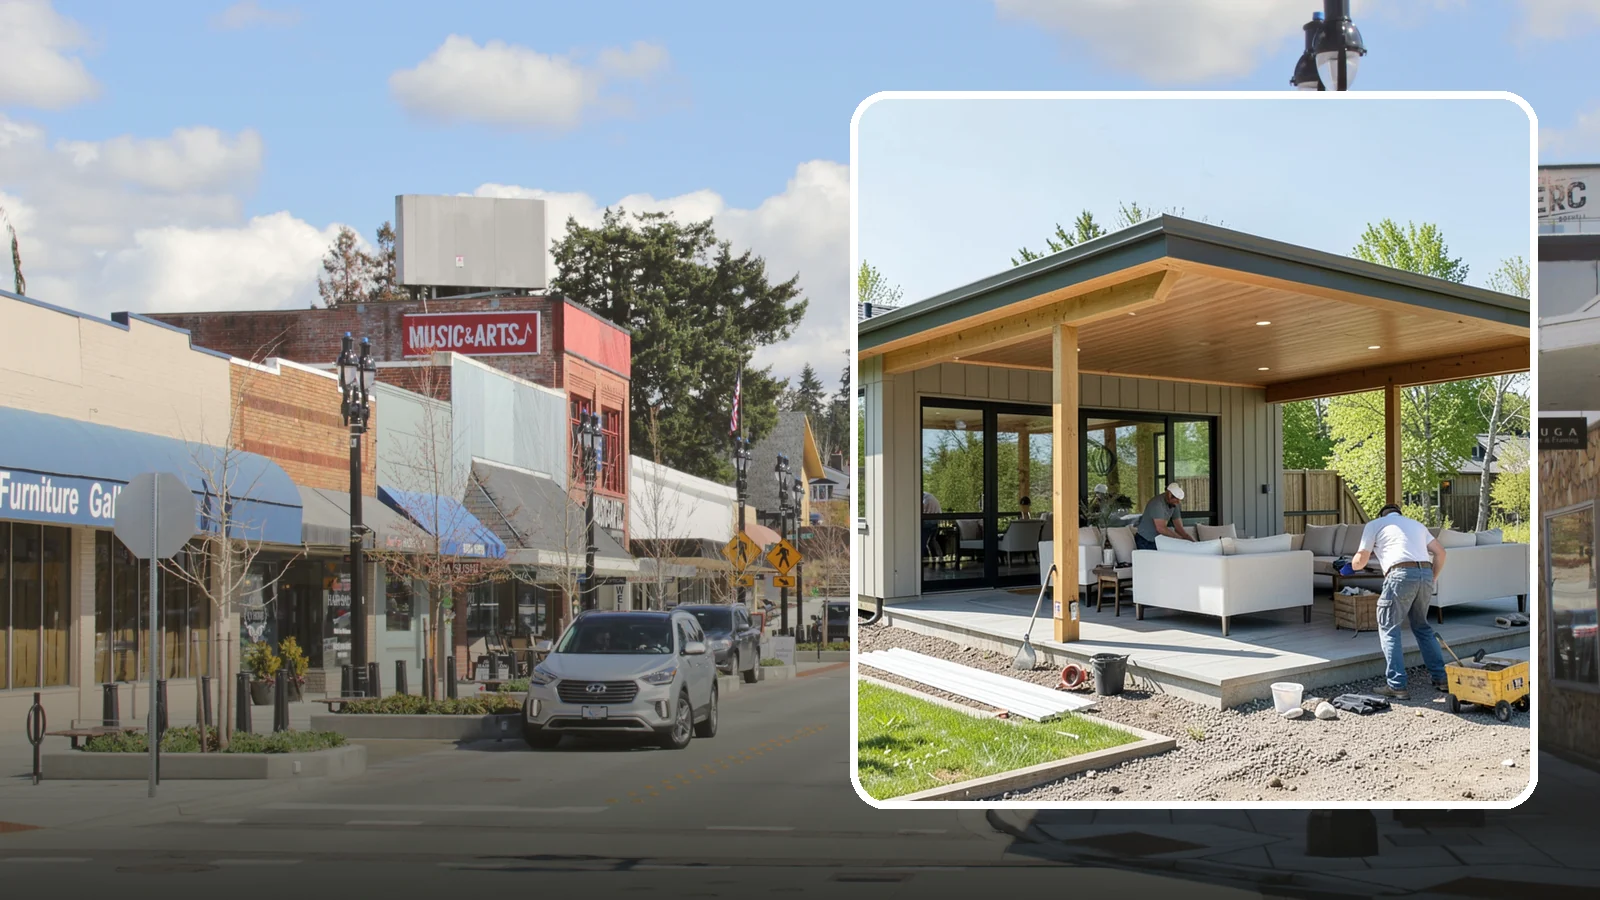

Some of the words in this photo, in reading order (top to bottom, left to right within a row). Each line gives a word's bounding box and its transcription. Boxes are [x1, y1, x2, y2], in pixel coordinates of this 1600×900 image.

[1540, 427, 1577, 437] UGA
[0, 471, 79, 515] Furniture
[453, 563, 480, 574] SUSHI
